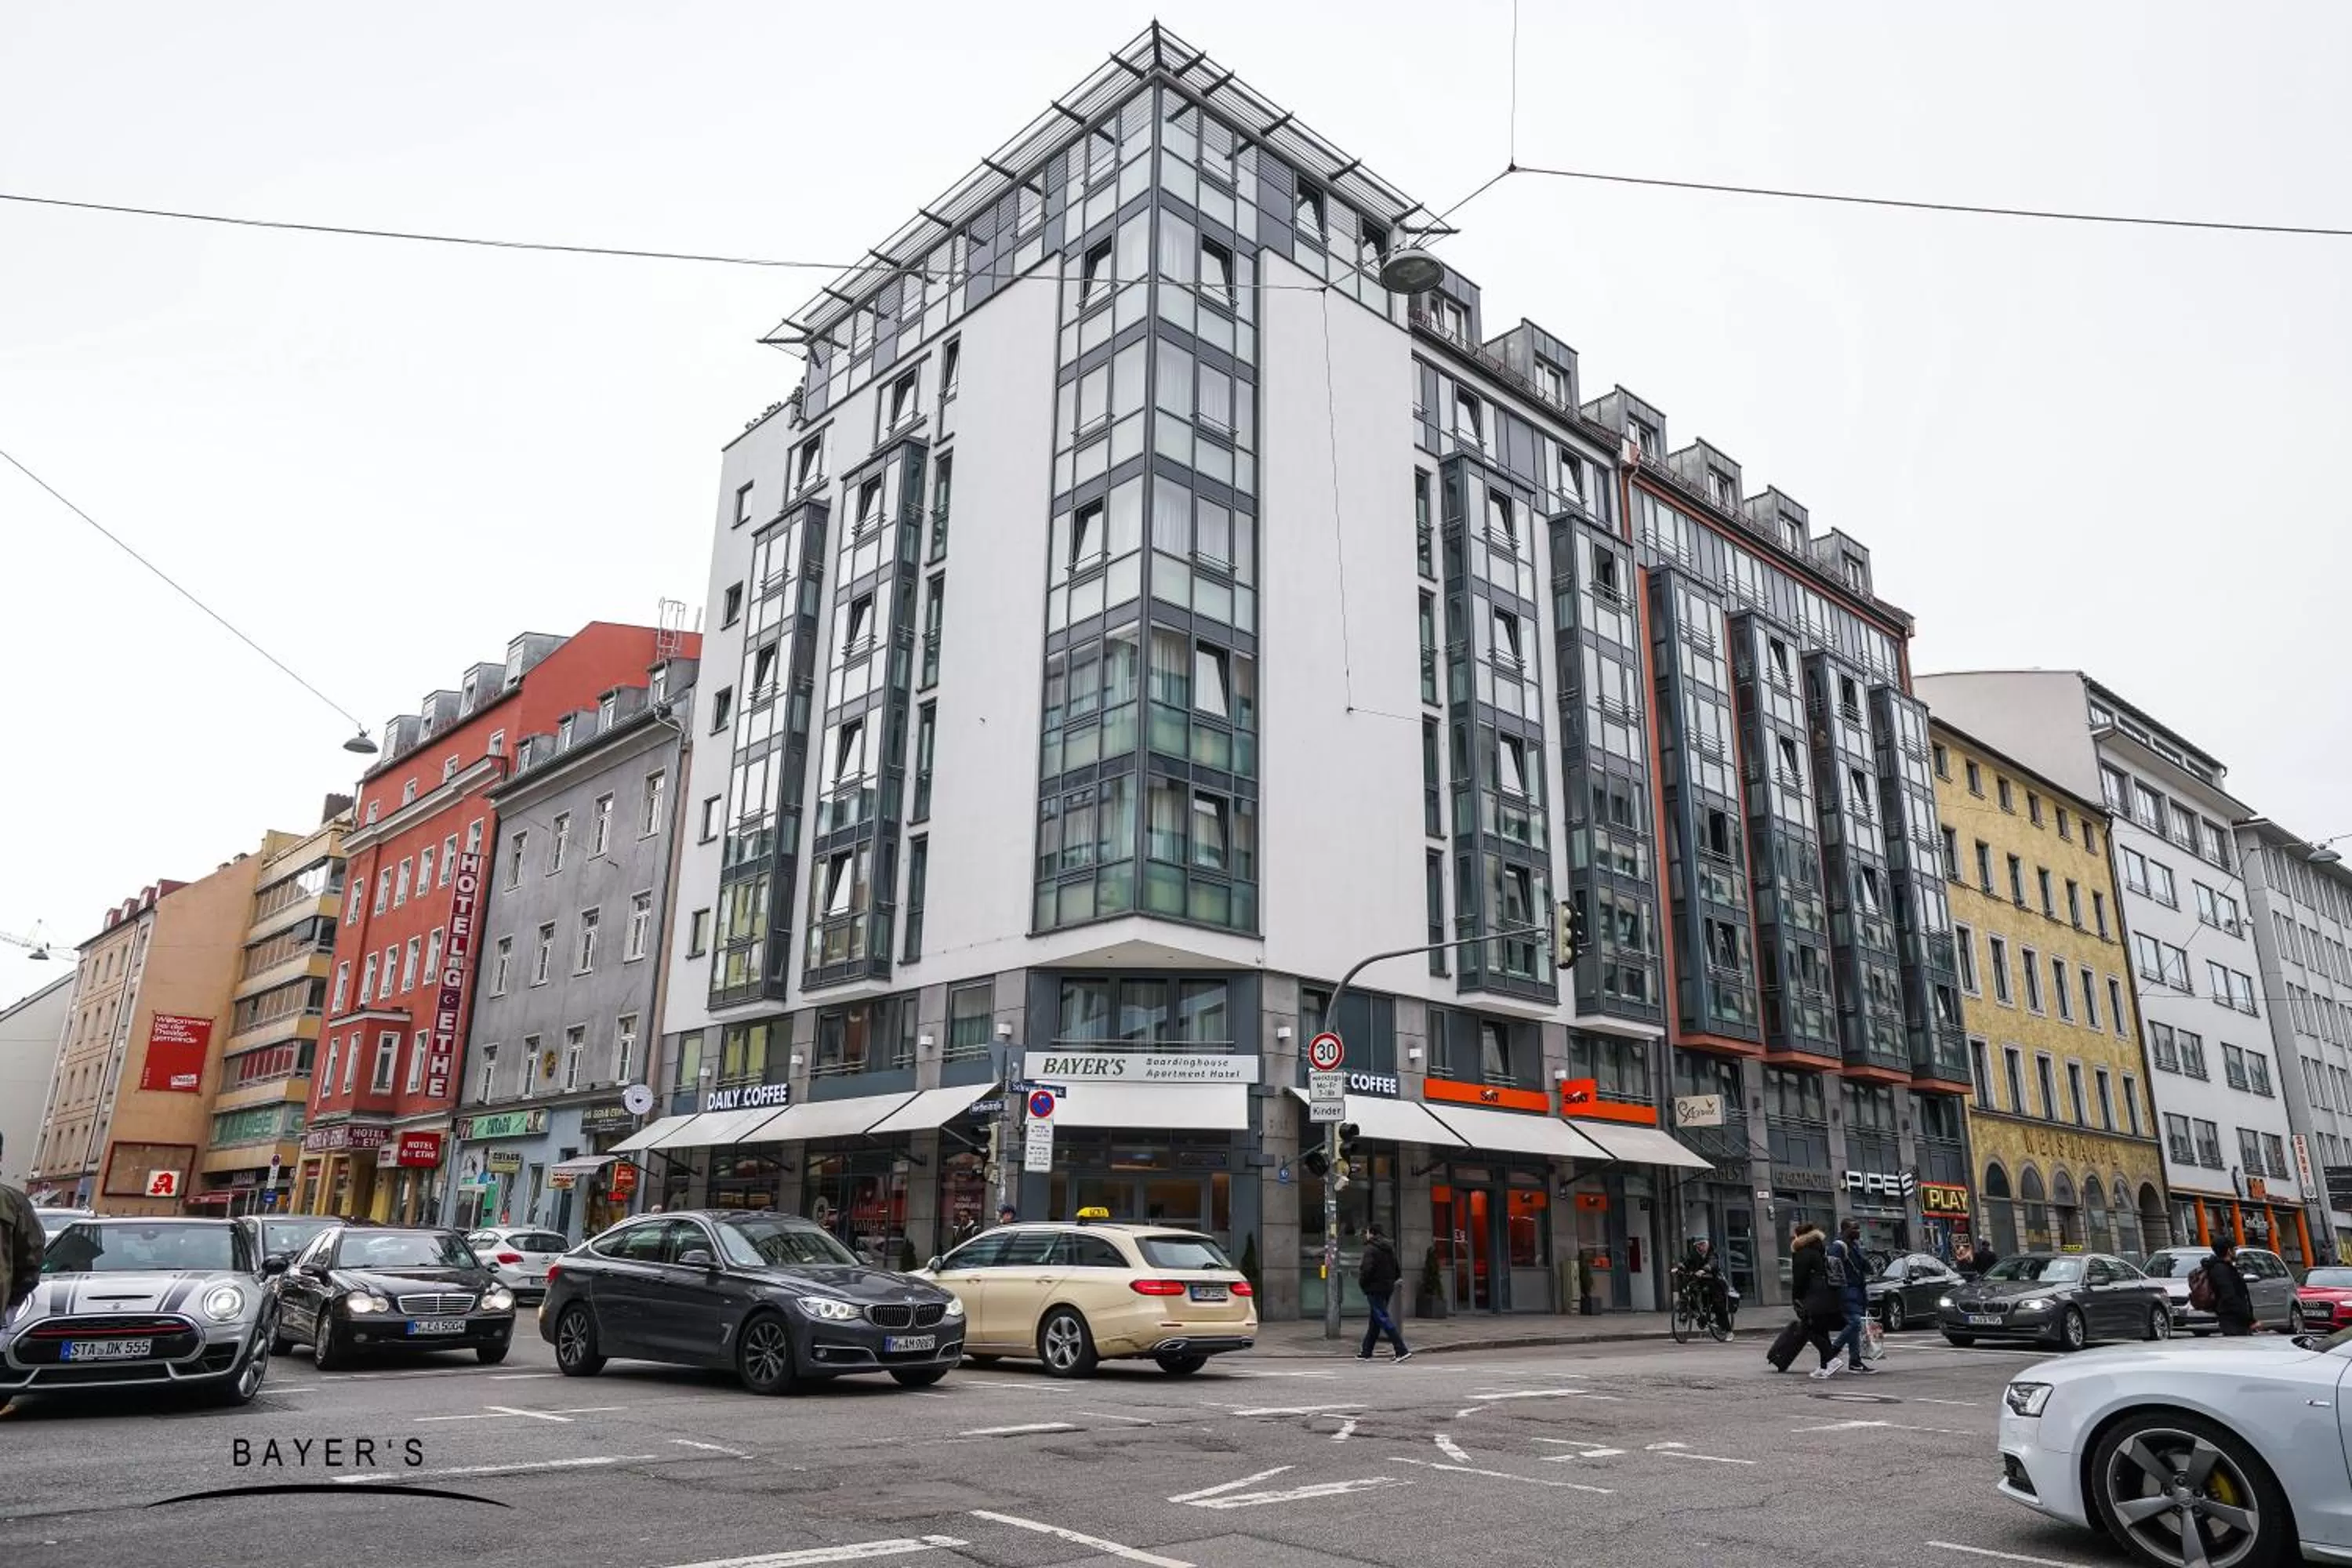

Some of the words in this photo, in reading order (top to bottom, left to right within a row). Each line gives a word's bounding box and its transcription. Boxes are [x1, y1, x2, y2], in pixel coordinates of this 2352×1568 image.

[448, 853, 478, 956] HOTEL
[1317, 1044, 1336, 1061] 30
[1043, 1058, 1127, 1076] BAYER'S
[1351, 1073, 1396, 1094] COFFEE
[707, 1089, 741, 1111] DAILY
[744, 1083, 787, 1106] COFFEE
[1313, 1107, 1341, 1116] Kinder
[407, 1141, 434, 1149] HOTEL
[1846, 1171, 1915, 1196] PIPES
[1929, 1189, 1969, 1210] PLAY
[125, 1341, 150, 1353] 555
